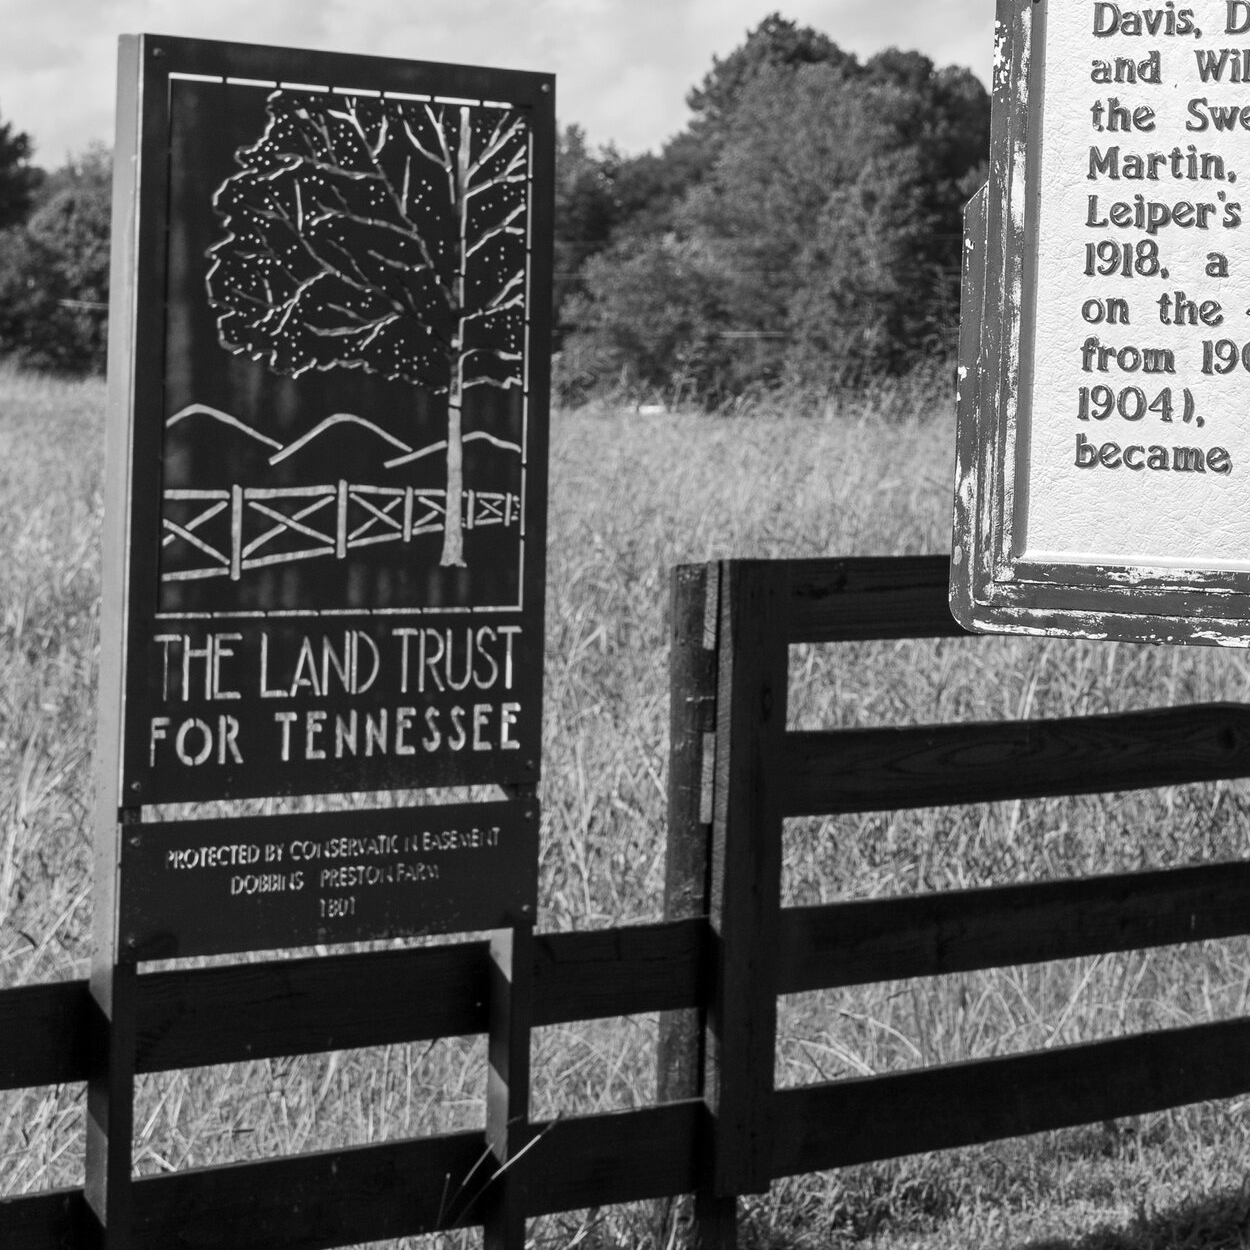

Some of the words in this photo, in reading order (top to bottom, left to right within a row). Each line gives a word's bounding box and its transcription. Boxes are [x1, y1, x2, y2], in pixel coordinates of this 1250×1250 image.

[1092, 1, 1202, 38] Davis,
[1091, 51, 1162, 84] and
[1090, 97, 1155, 132] the
[1087, 145, 1236, 183] Martin,
[1085, 191, 1241, 235] Leiper's
[1084, 239, 1169, 279] 1918,
[1206, 253, 1229, 278] a
[1082, 298, 1130, 324] on
[1156, 292, 1223, 326] the
[1080, 337, 1176, 374] from
[1077, 385, 1204, 427] 1904),
[1074, 433, 1233, 474] became
[154, 633, 243, 701] THE
[260, 630, 380, 698] LAND
[392, 626, 522, 693] TRUST
[150, 714, 243, 767] FOR
[275, 702, 521, 761] TENNESSEE
[166, 844, 260, 869] PROTECTED
[264, 843, 285, 862] BY
